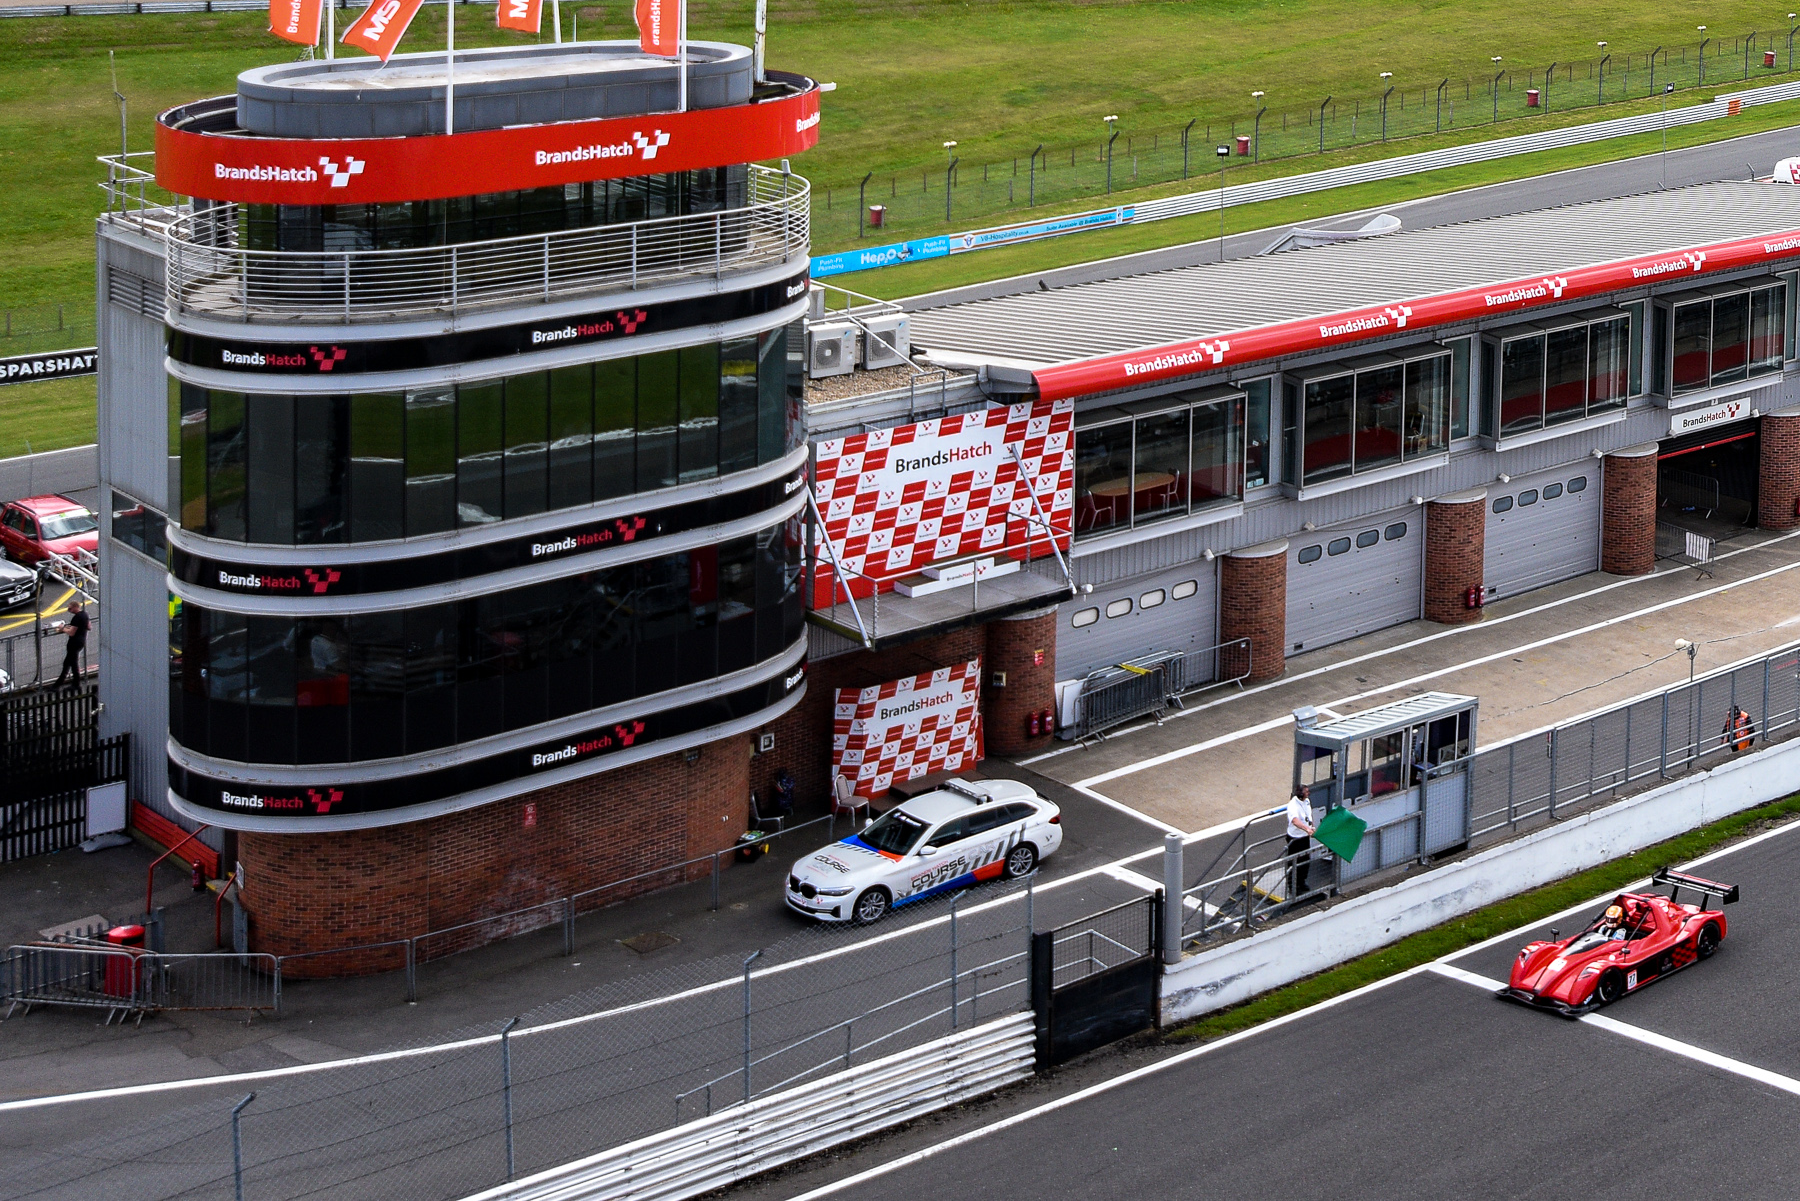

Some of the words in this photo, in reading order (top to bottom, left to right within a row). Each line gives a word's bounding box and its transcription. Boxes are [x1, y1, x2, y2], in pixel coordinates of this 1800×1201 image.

[535, 142, 633, 166] BrandsHatch
[214, 163, 318, 182] BrandsHatch
[922, 245, 948, 254] Plumbing
[924, 239, 946, 248] Push-Fit
[817, 263, 845, 272] Plumbing
[819, 257, 843, 266] Push-Fit
[1632, 258, 1687, 280] BrandsHatch
[1484, 285, 1547, 307] BrandsHatch
[532, 321, 614, 344] BrandsHatch
[1319, 315, 1388, 338] BrandsHatch
[0, 353, 98, 378] SPARSHAT
[222, 349, 306, 367] BrandsHatch
[1124, 350, 1203, 377] BrandsHatch
[1682, 409, 1727, 429] BrandsHatch
[895, 441, 992, 474] BrandsHatch
[531, 529, 613, 557] BrandsHatch
[218, 570, 301, 590] BrandsHatch
[880, 691, 953, 720] BrandsHatch
[532, 734, 612, 767] BrandsHatch
[221, 791, 304, 810] BrandsHatch
[814, 854, 851, 874] COURSE
[912, 856, 966, 888] COURSE
[1628, 973, 1636, 984] 77
